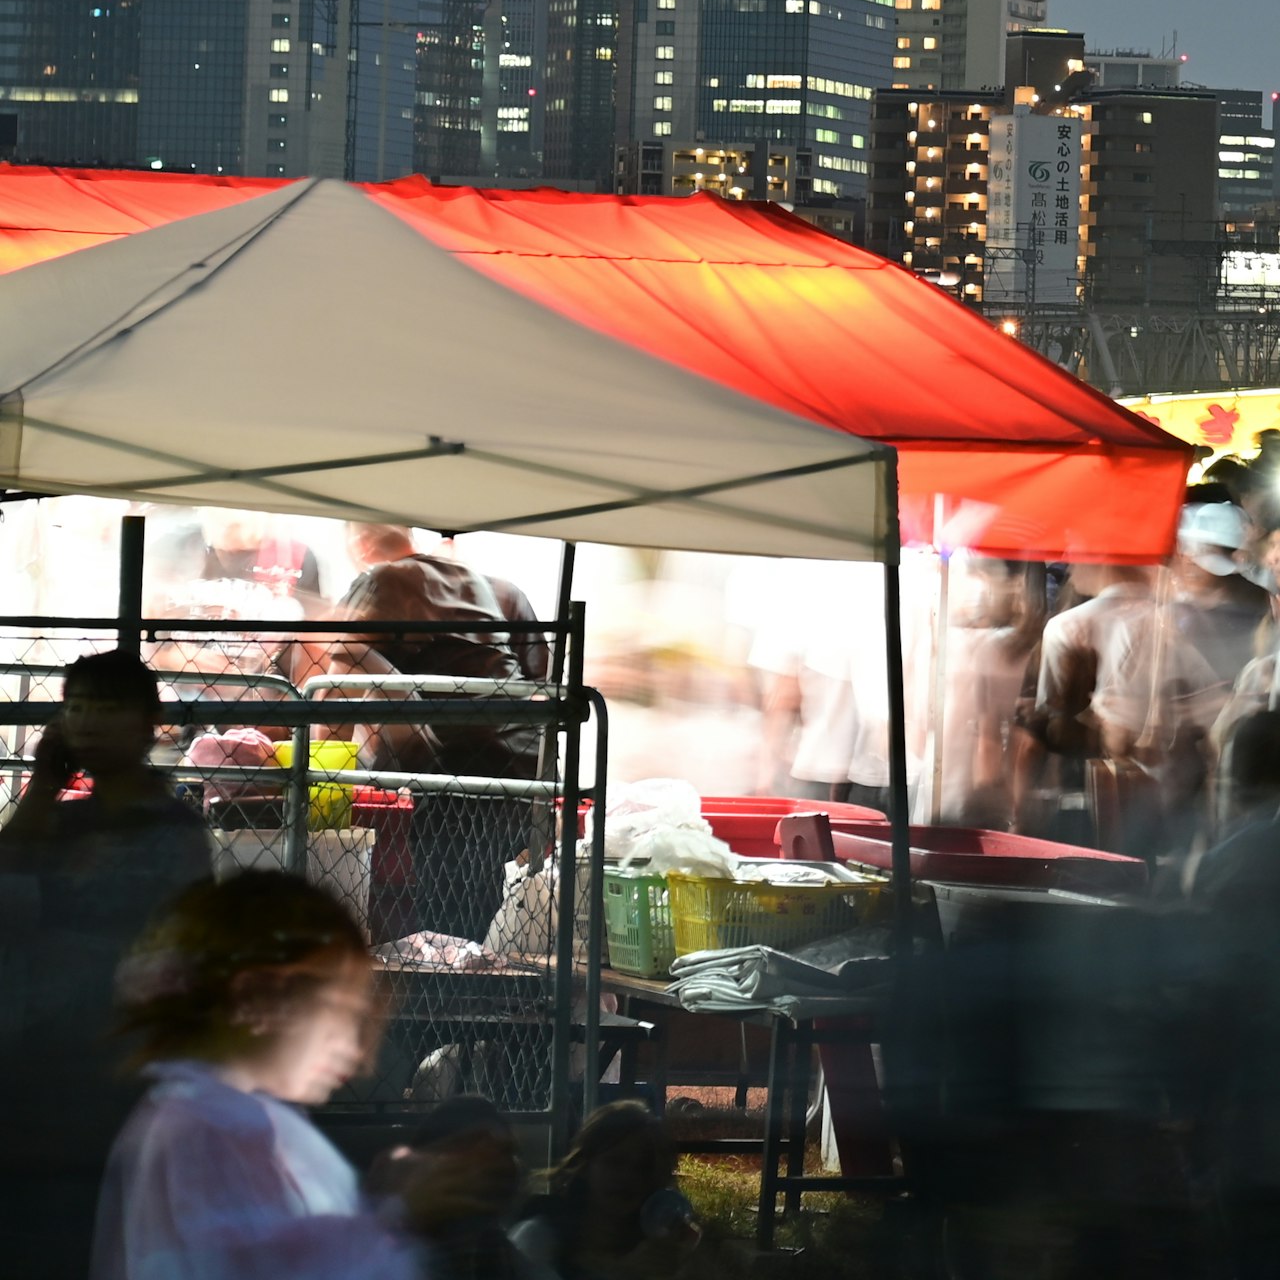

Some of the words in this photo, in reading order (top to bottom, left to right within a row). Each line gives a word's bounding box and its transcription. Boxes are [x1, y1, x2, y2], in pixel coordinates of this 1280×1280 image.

[1054, 125, 1072, 245] 安心の土地活用
